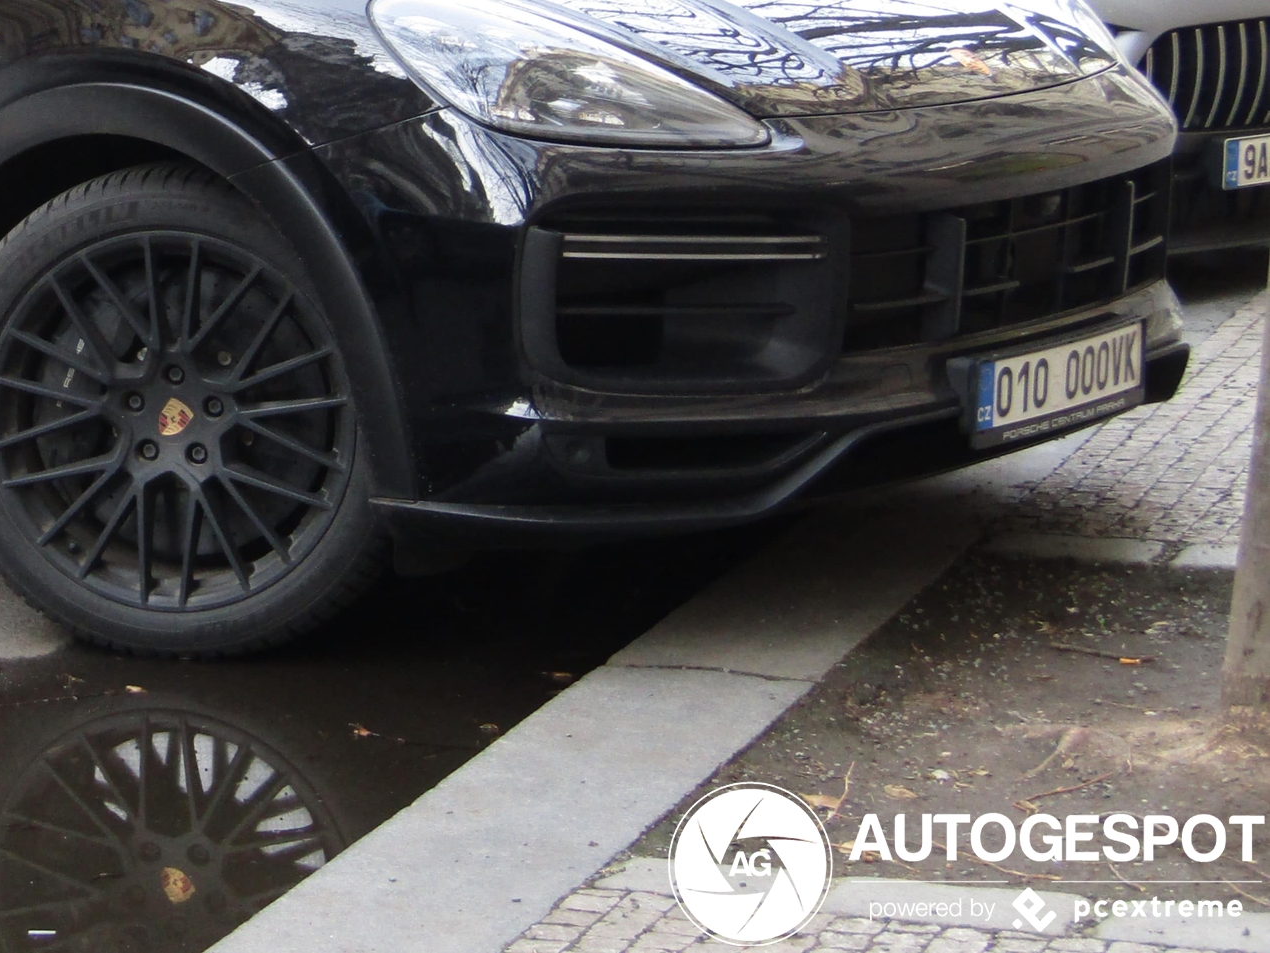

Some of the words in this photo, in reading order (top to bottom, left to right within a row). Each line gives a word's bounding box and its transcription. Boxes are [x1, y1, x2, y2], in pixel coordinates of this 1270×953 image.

[996, 358, 1049, 417] 010
[977, 407, 991, 422] CZ
[1002, 420, 1050, 441] PORSCHE
[1051, 408, 1095, 427] CENTRUM
[1096, 398, 1125, 414] PRAHA
